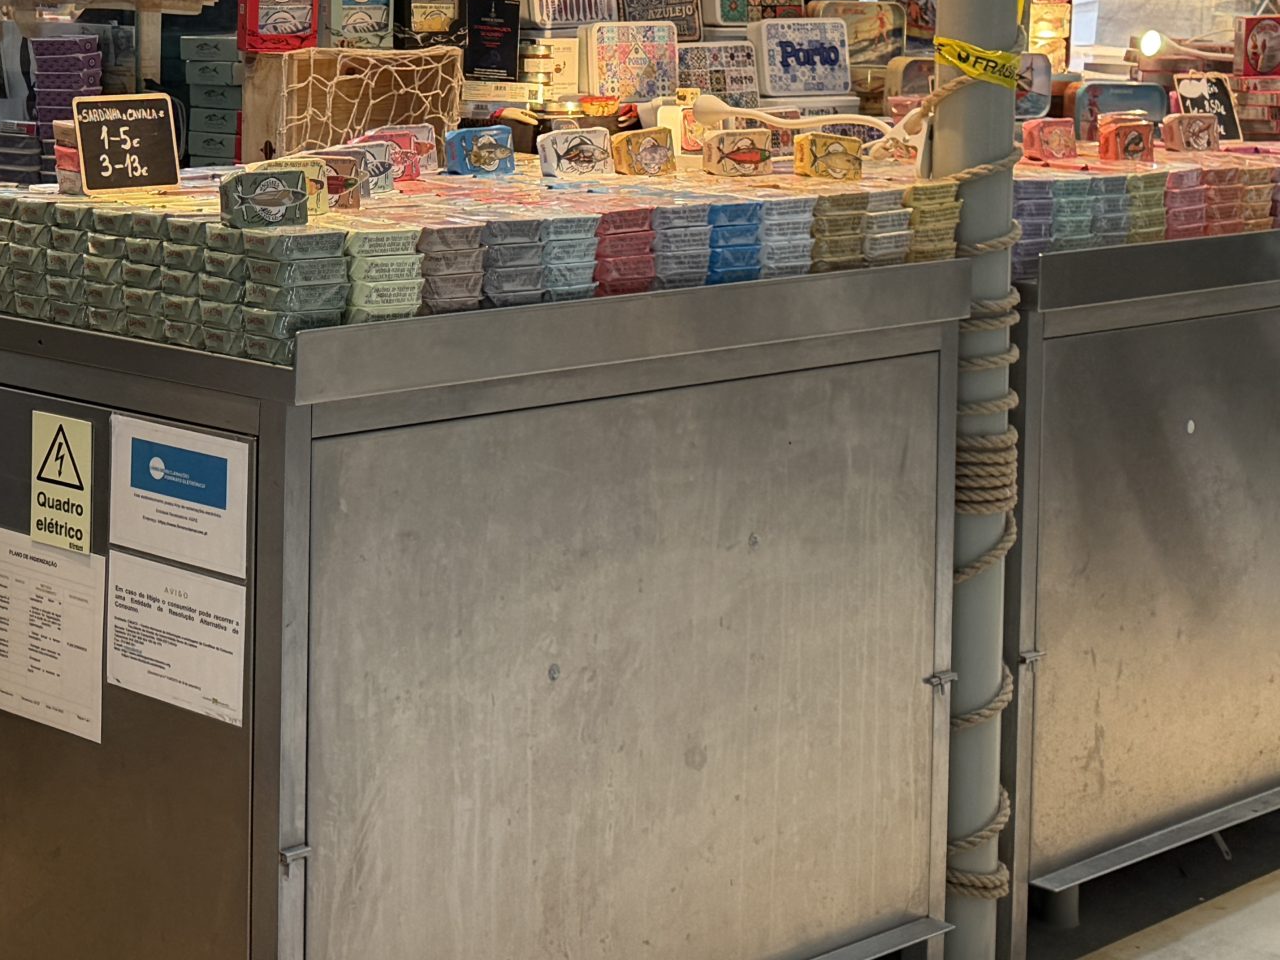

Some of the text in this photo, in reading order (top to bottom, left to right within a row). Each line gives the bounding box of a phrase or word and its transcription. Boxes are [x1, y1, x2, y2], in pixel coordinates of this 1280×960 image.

[648, 4, 694, 20] AZULEJO
[778, 41, 840, 68] Porto
[127, 108, 158, 121] CAVALA
[37, 491, 83, 516] Quadro
[36, 517, 83, 541] elétrico
[164, 587, 189, 599] AVISO
[125, 589, 137, 597] caso
[167, 600, 197, 614] consumidor
[198, 608, 212, 620] pode
[213, 614, 234, 626] recorrer
